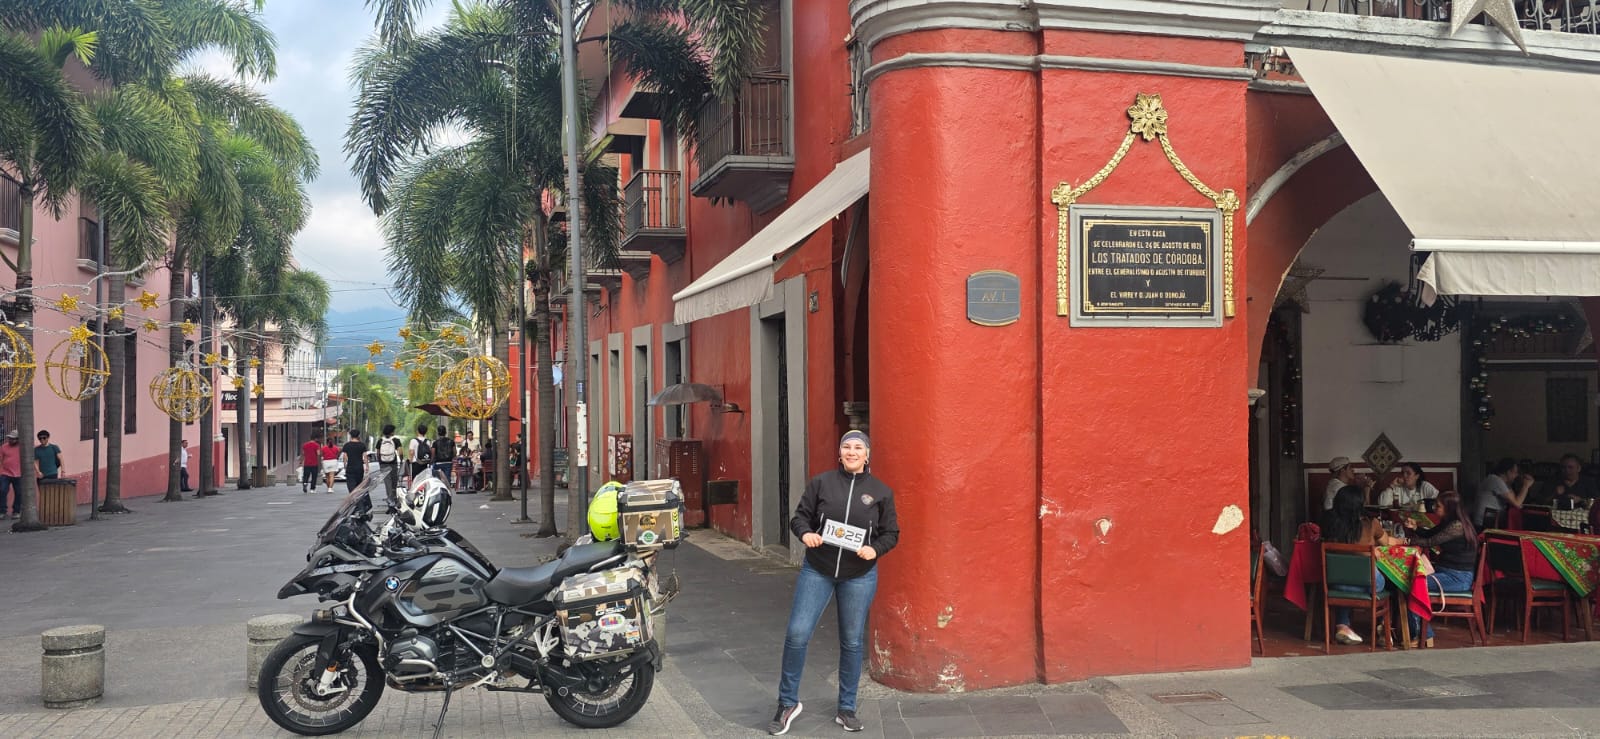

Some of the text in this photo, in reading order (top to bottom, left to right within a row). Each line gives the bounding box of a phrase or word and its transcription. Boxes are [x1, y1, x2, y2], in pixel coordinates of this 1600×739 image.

[1138, 229, 1151, 237] ESTA
[1152, 230, 1166, 238] CASA
[1093, 240, 1101, 248] SE
[1101, 240, 1136, 249] CELEBRARON
[1137, 241, 1144, 249] EL
[1145, 241, 1152, 250] 24
[1153, 241, 1160, 249] DE
[1161, 241, 1182, 249] AGOSTO
[1183, 242, 1190, 250] DE
[1091, 252, 1108, 264] LOS
[1110, 252, 1151, 264] TRATADOS
[1152, 253, 1163, 264] DE
[1088, 267, 1104, 276] ENTRE
[1105, 267, 1112, 276] EL
[1110, 291, 1118, 299] EL
[844, 530, 862, 543] 25
